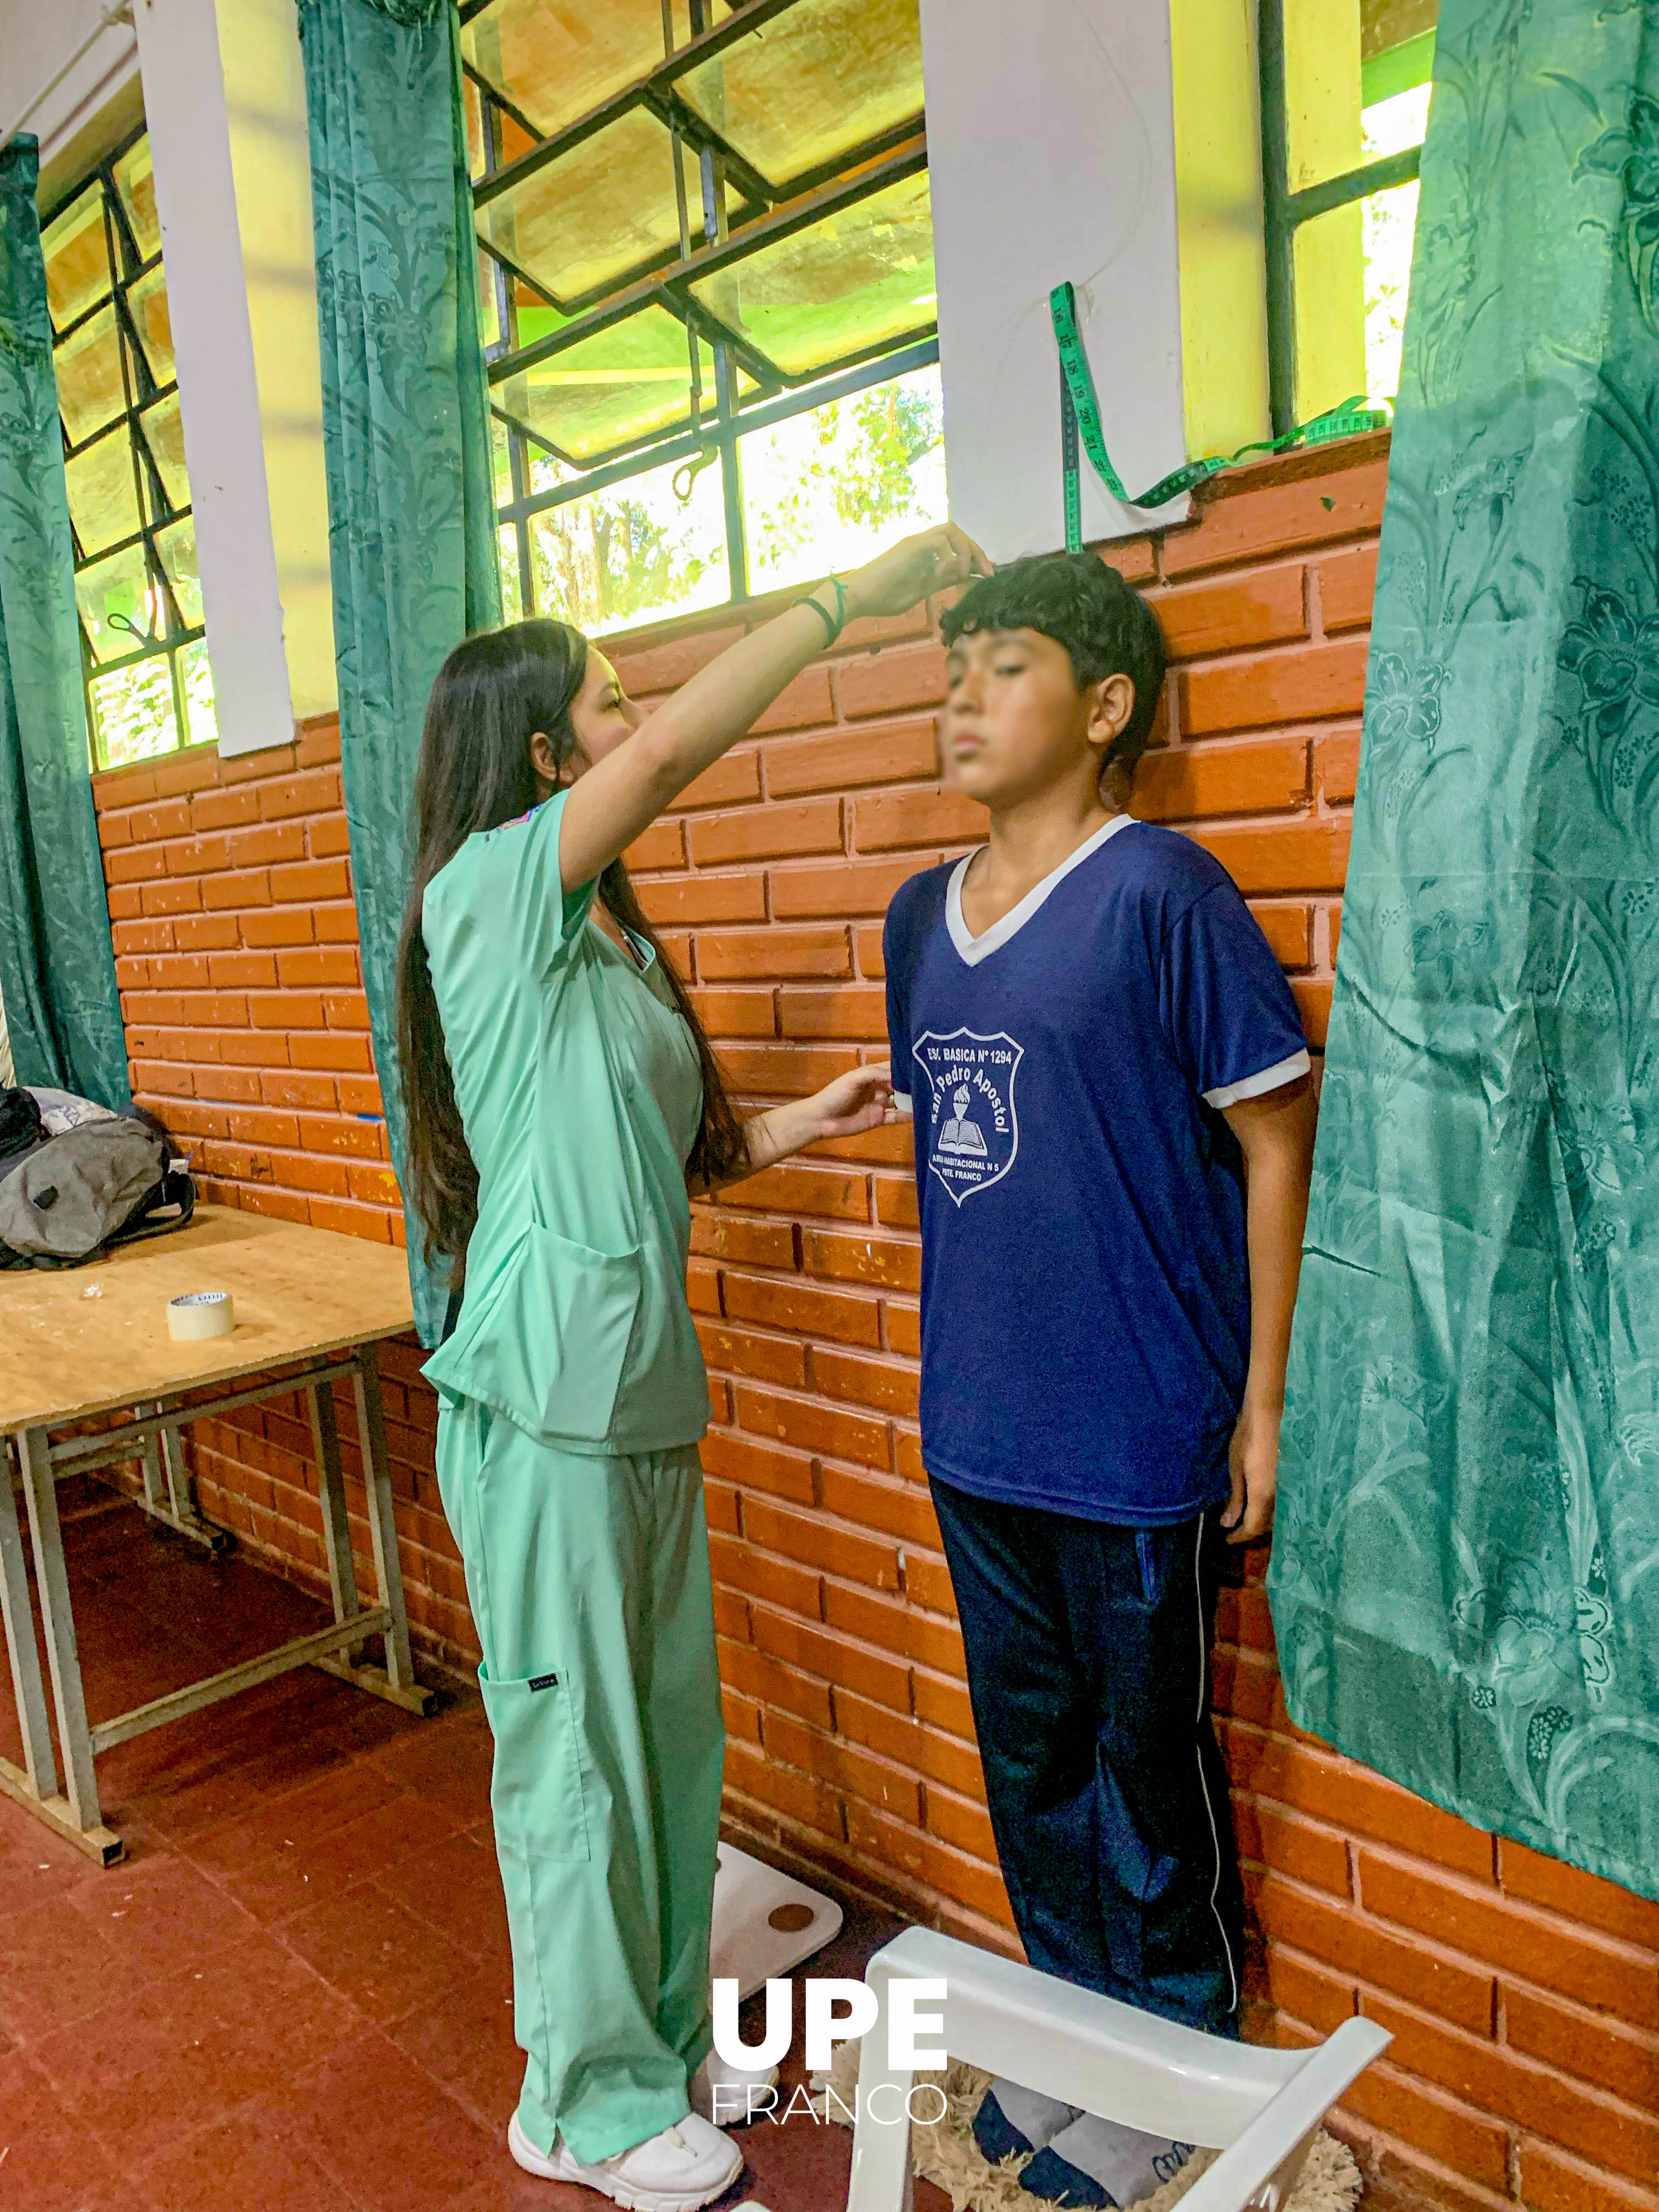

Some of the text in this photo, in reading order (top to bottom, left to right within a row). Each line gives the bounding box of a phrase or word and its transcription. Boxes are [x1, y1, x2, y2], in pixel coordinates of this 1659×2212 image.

[1054, 307, 1063, 323] 16
[1067, 359, 1078, 375] 18
[1074, 385, 1085, 399] 19
[1080, 408, 1091, 425] 20
[1086, 435, 1097, 450] 21
[943, 1048, 975, 1062] BASICA
[990, 1050, 1012, 1064] 1294
[936, 1064, 970, 1093] Pedro
[973, 1069, 1009, 1132] Apostol
[955, 1171, 981, 1182] FRANCO
